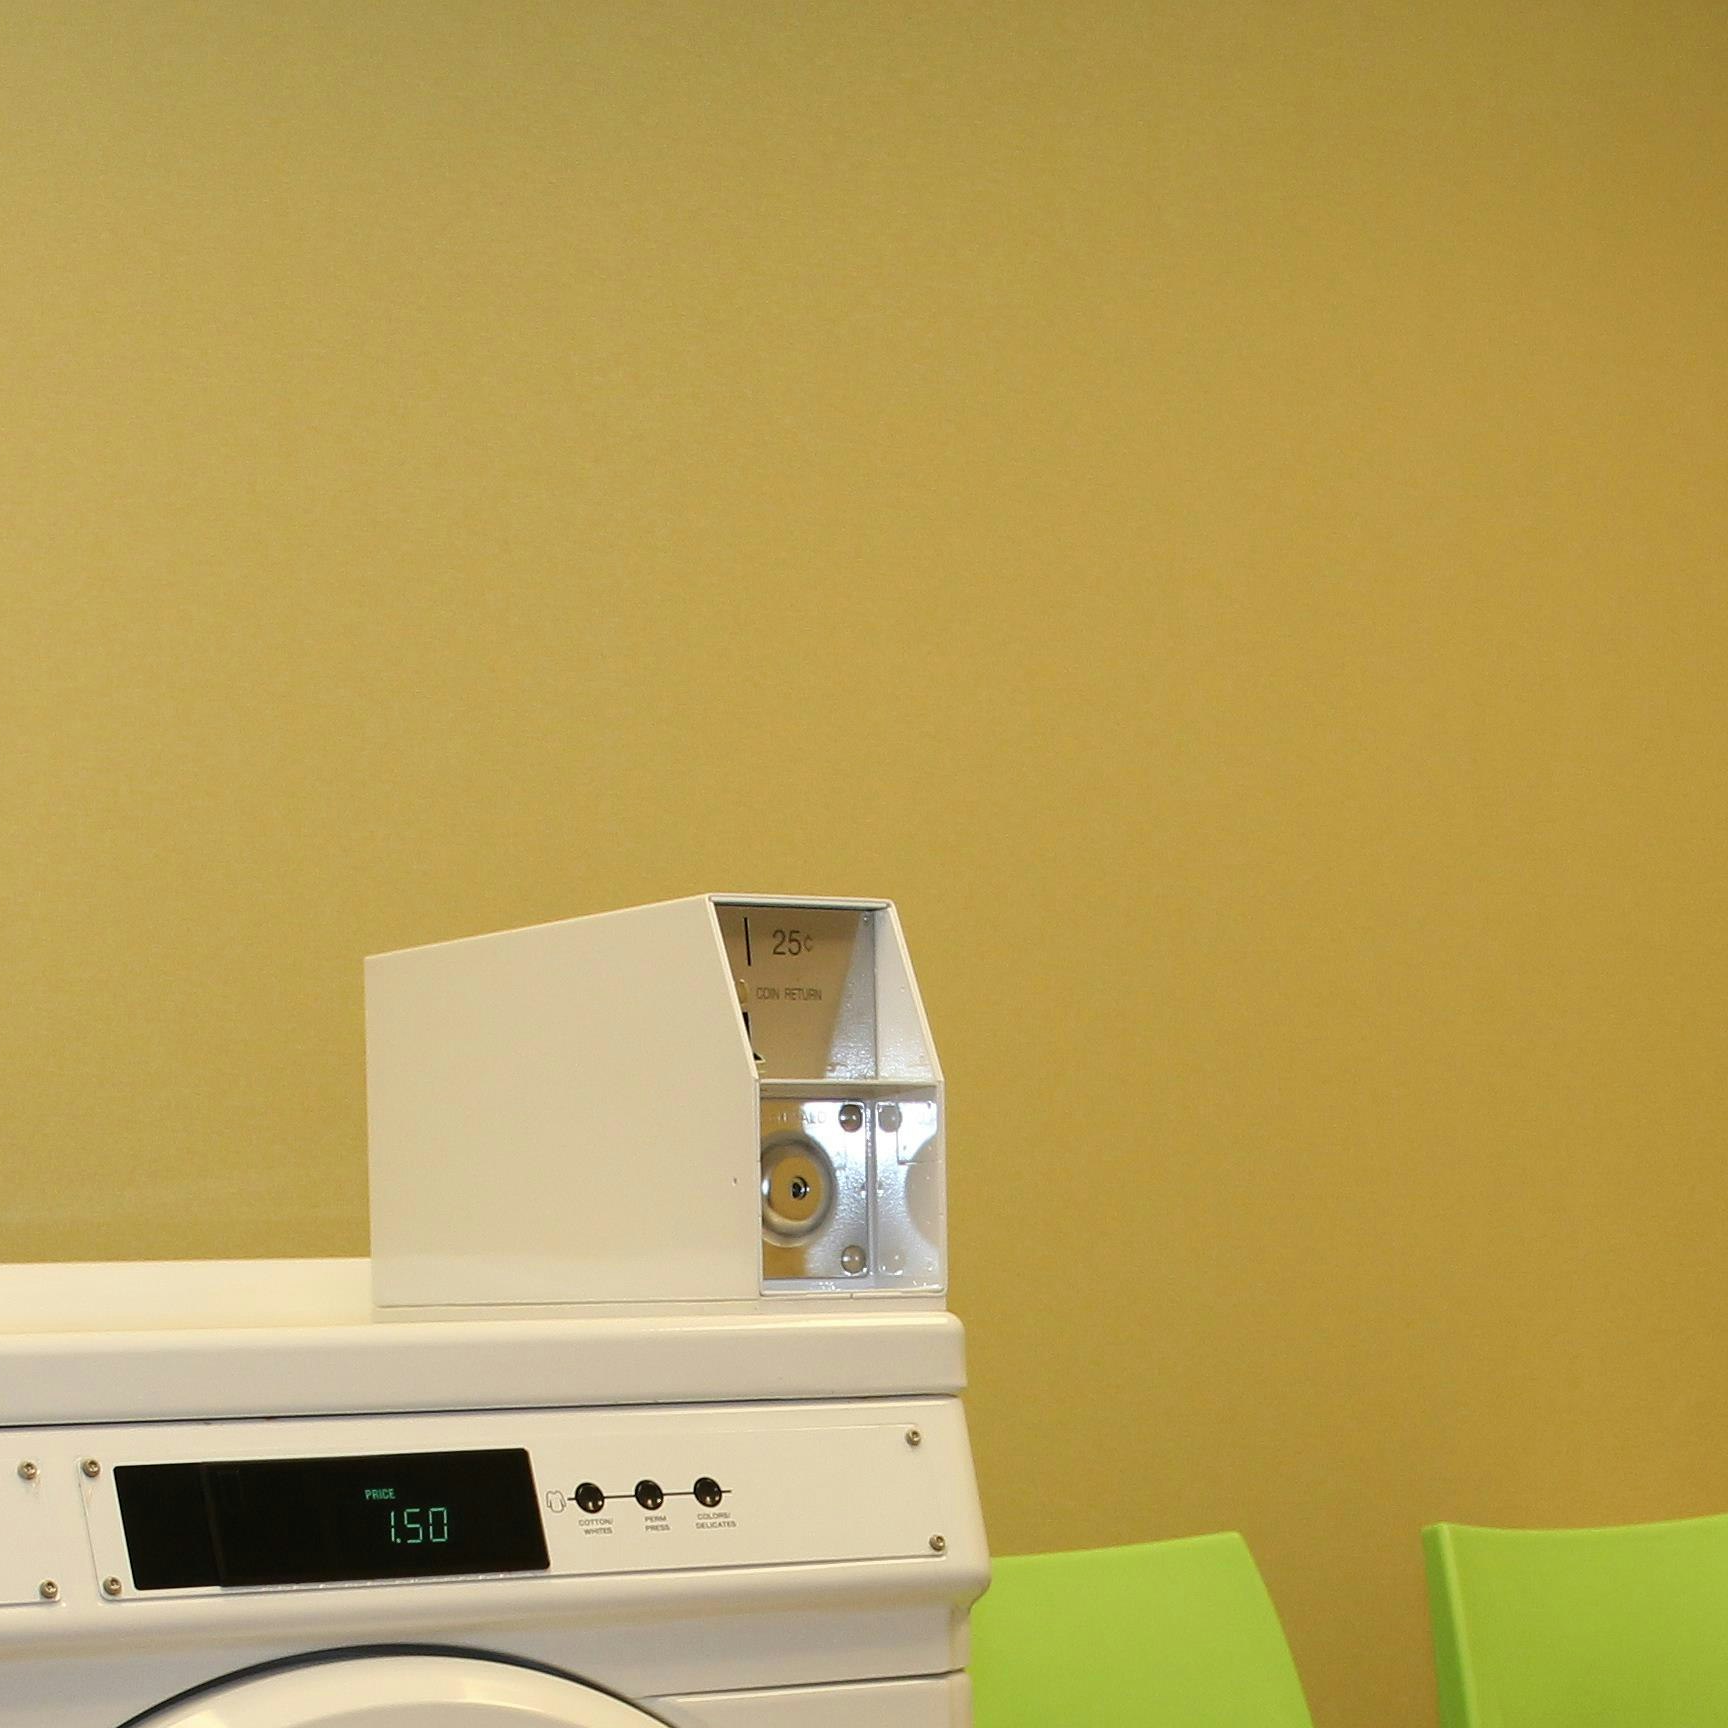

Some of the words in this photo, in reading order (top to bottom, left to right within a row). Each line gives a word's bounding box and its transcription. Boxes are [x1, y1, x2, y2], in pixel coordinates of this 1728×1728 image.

[756, 986, 780, 1000] COIN
[785, 987, 823, 1001] RETURN
[364, 1488, 397, 1500] PRICE
[644, 1515, 667, 1523] PERM
[390, 1507, 449, 1543] 1.50
[645, 1523, 671, 1532] PRESS
[695, 1520, 737, 1530] DELICATES
